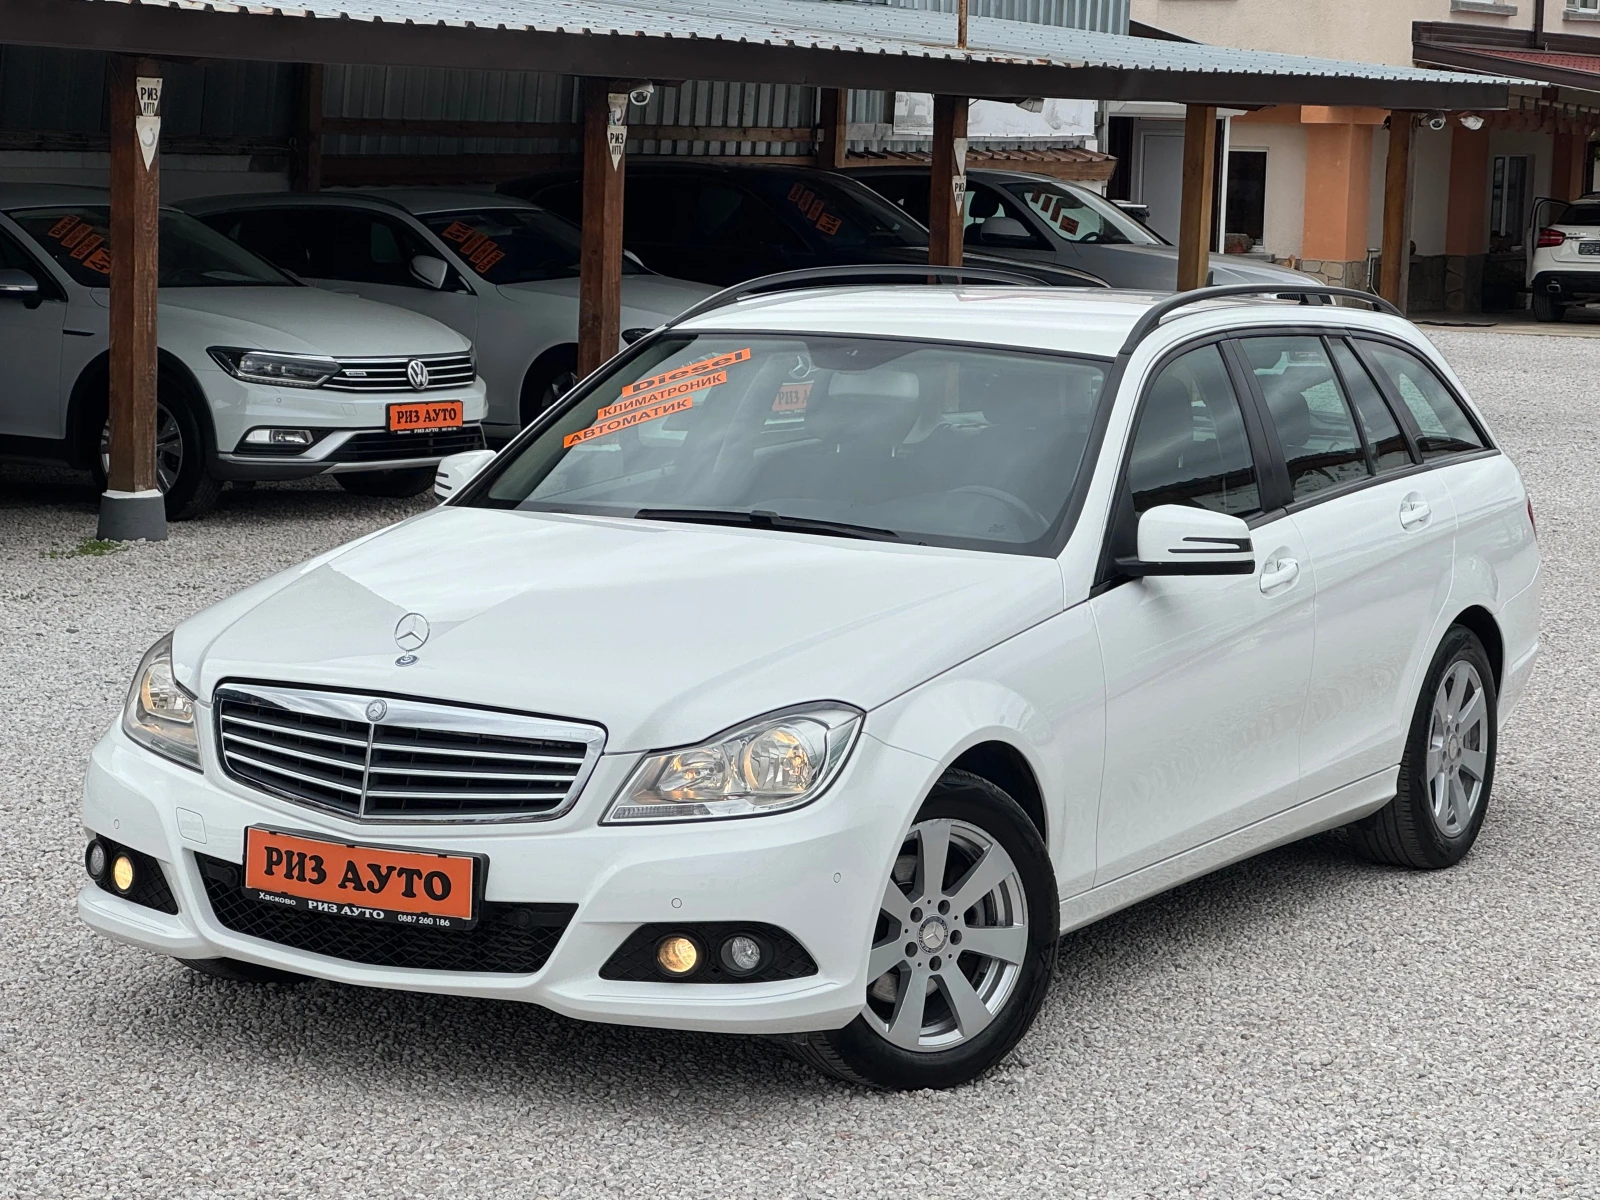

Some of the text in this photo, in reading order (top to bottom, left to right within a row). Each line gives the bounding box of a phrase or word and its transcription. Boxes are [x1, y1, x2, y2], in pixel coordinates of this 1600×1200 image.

[141, 87, 158, 101] РИЗ
[610, 133, 624, 144] РИЗ
[632, 351, 743, 393] Diesel
[603, 373, 722, 417] КЛИМАТРОНИК
[396, 408, 457, 424] РИЗ АУТО
[569, 399, 688, 445] АВТОМАТИК
[264, 846, 452, 901] РИЗ АУТО
[259, 891, 297, 906] Хасково
[308, 901, 338, 913] РИЗ
[341, 906, 385, 919] АУТО
[419, 917, 434, 925] 260
[436, 919, 450, 927] 186
